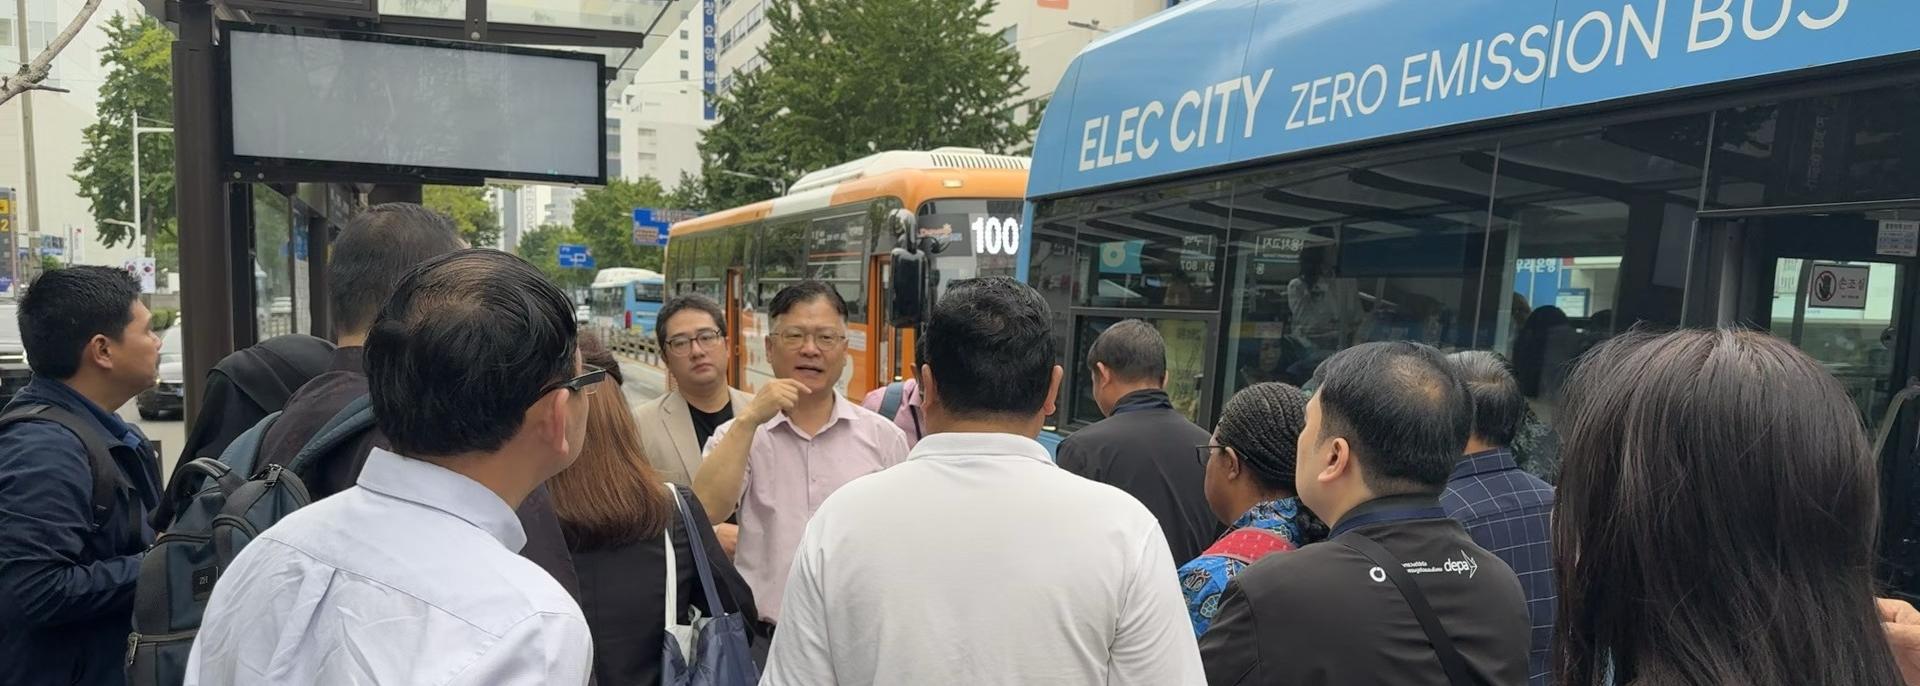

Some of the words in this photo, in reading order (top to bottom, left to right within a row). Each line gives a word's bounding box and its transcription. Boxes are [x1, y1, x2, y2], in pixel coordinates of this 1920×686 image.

[1078, 101, 1164, 172] ELEC
[1169, 68, 1274, 153] CITY
[1285, 64, 1388, 131] ZERO
[1398, 0, 1667, 107] EMISSION
[1443, 558, 1470, 574] depa
